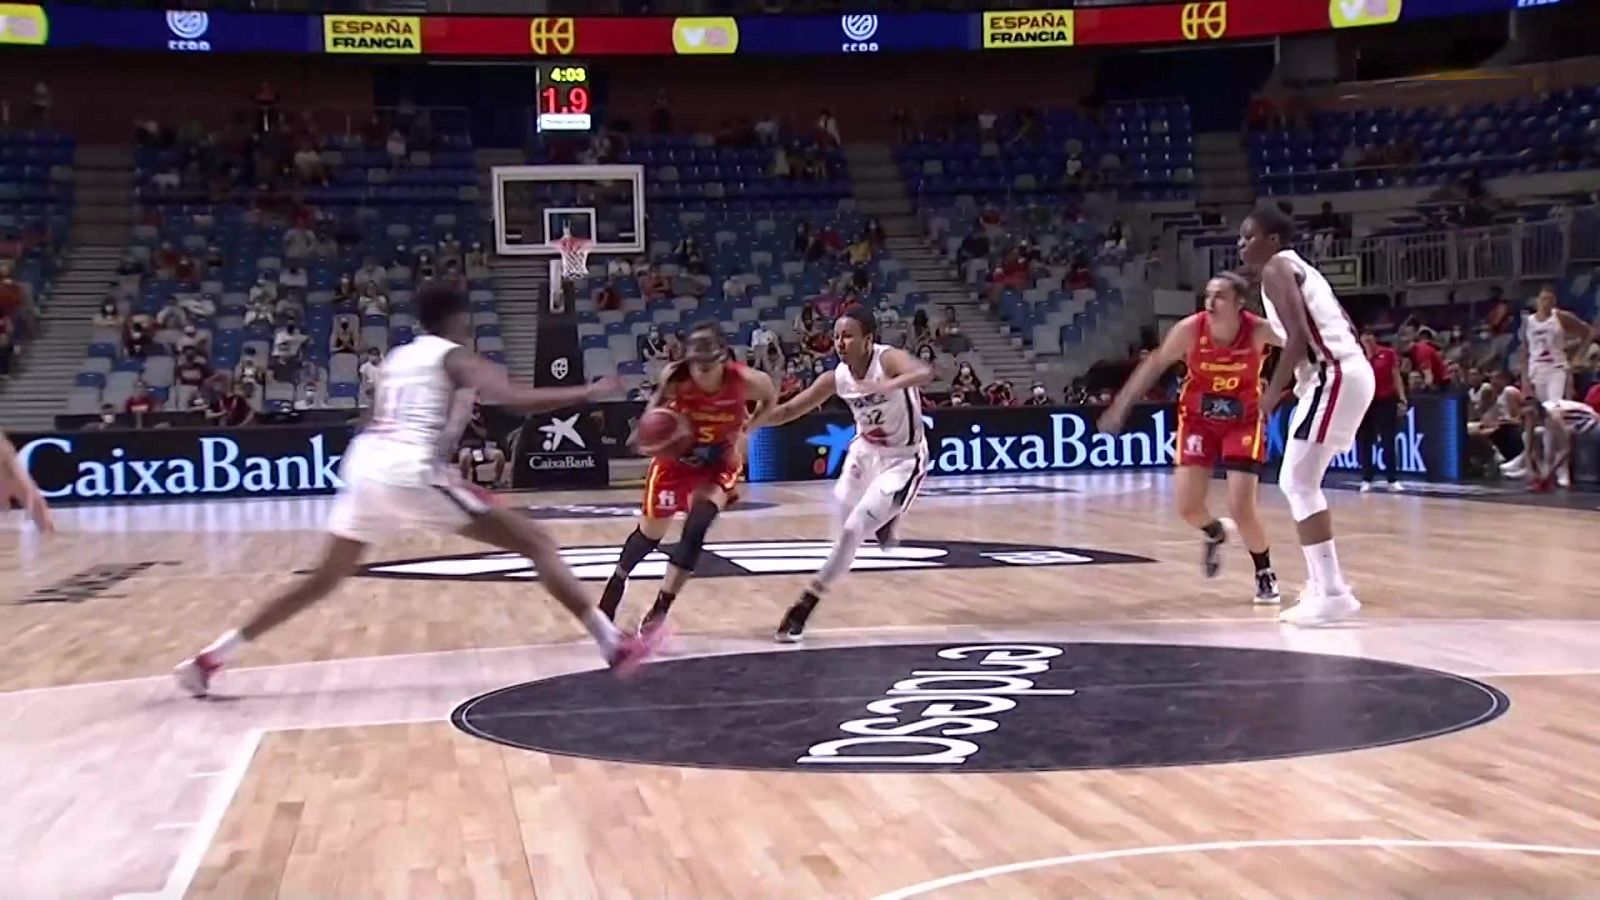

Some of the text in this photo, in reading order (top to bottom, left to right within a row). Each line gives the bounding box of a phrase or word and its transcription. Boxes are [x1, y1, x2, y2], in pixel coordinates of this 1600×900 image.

[332, 19, 413, 34] ESPAÑA
[990, 12, 1067, 29] ESPAÑA
[332, 37, 414, 49] FRANCIA
[990, 31, 1067, 43] FRANCIA
[550, 67, 586, 82] 4:03
[542, 87, 588, 114] 1.9
[1212, 376, 1240, 392] 20
[17, 433, 347, 498] CaixaBank
[529, 455, 596, 470] CaixaBank
[796, 644, 1076, 764] endesa
